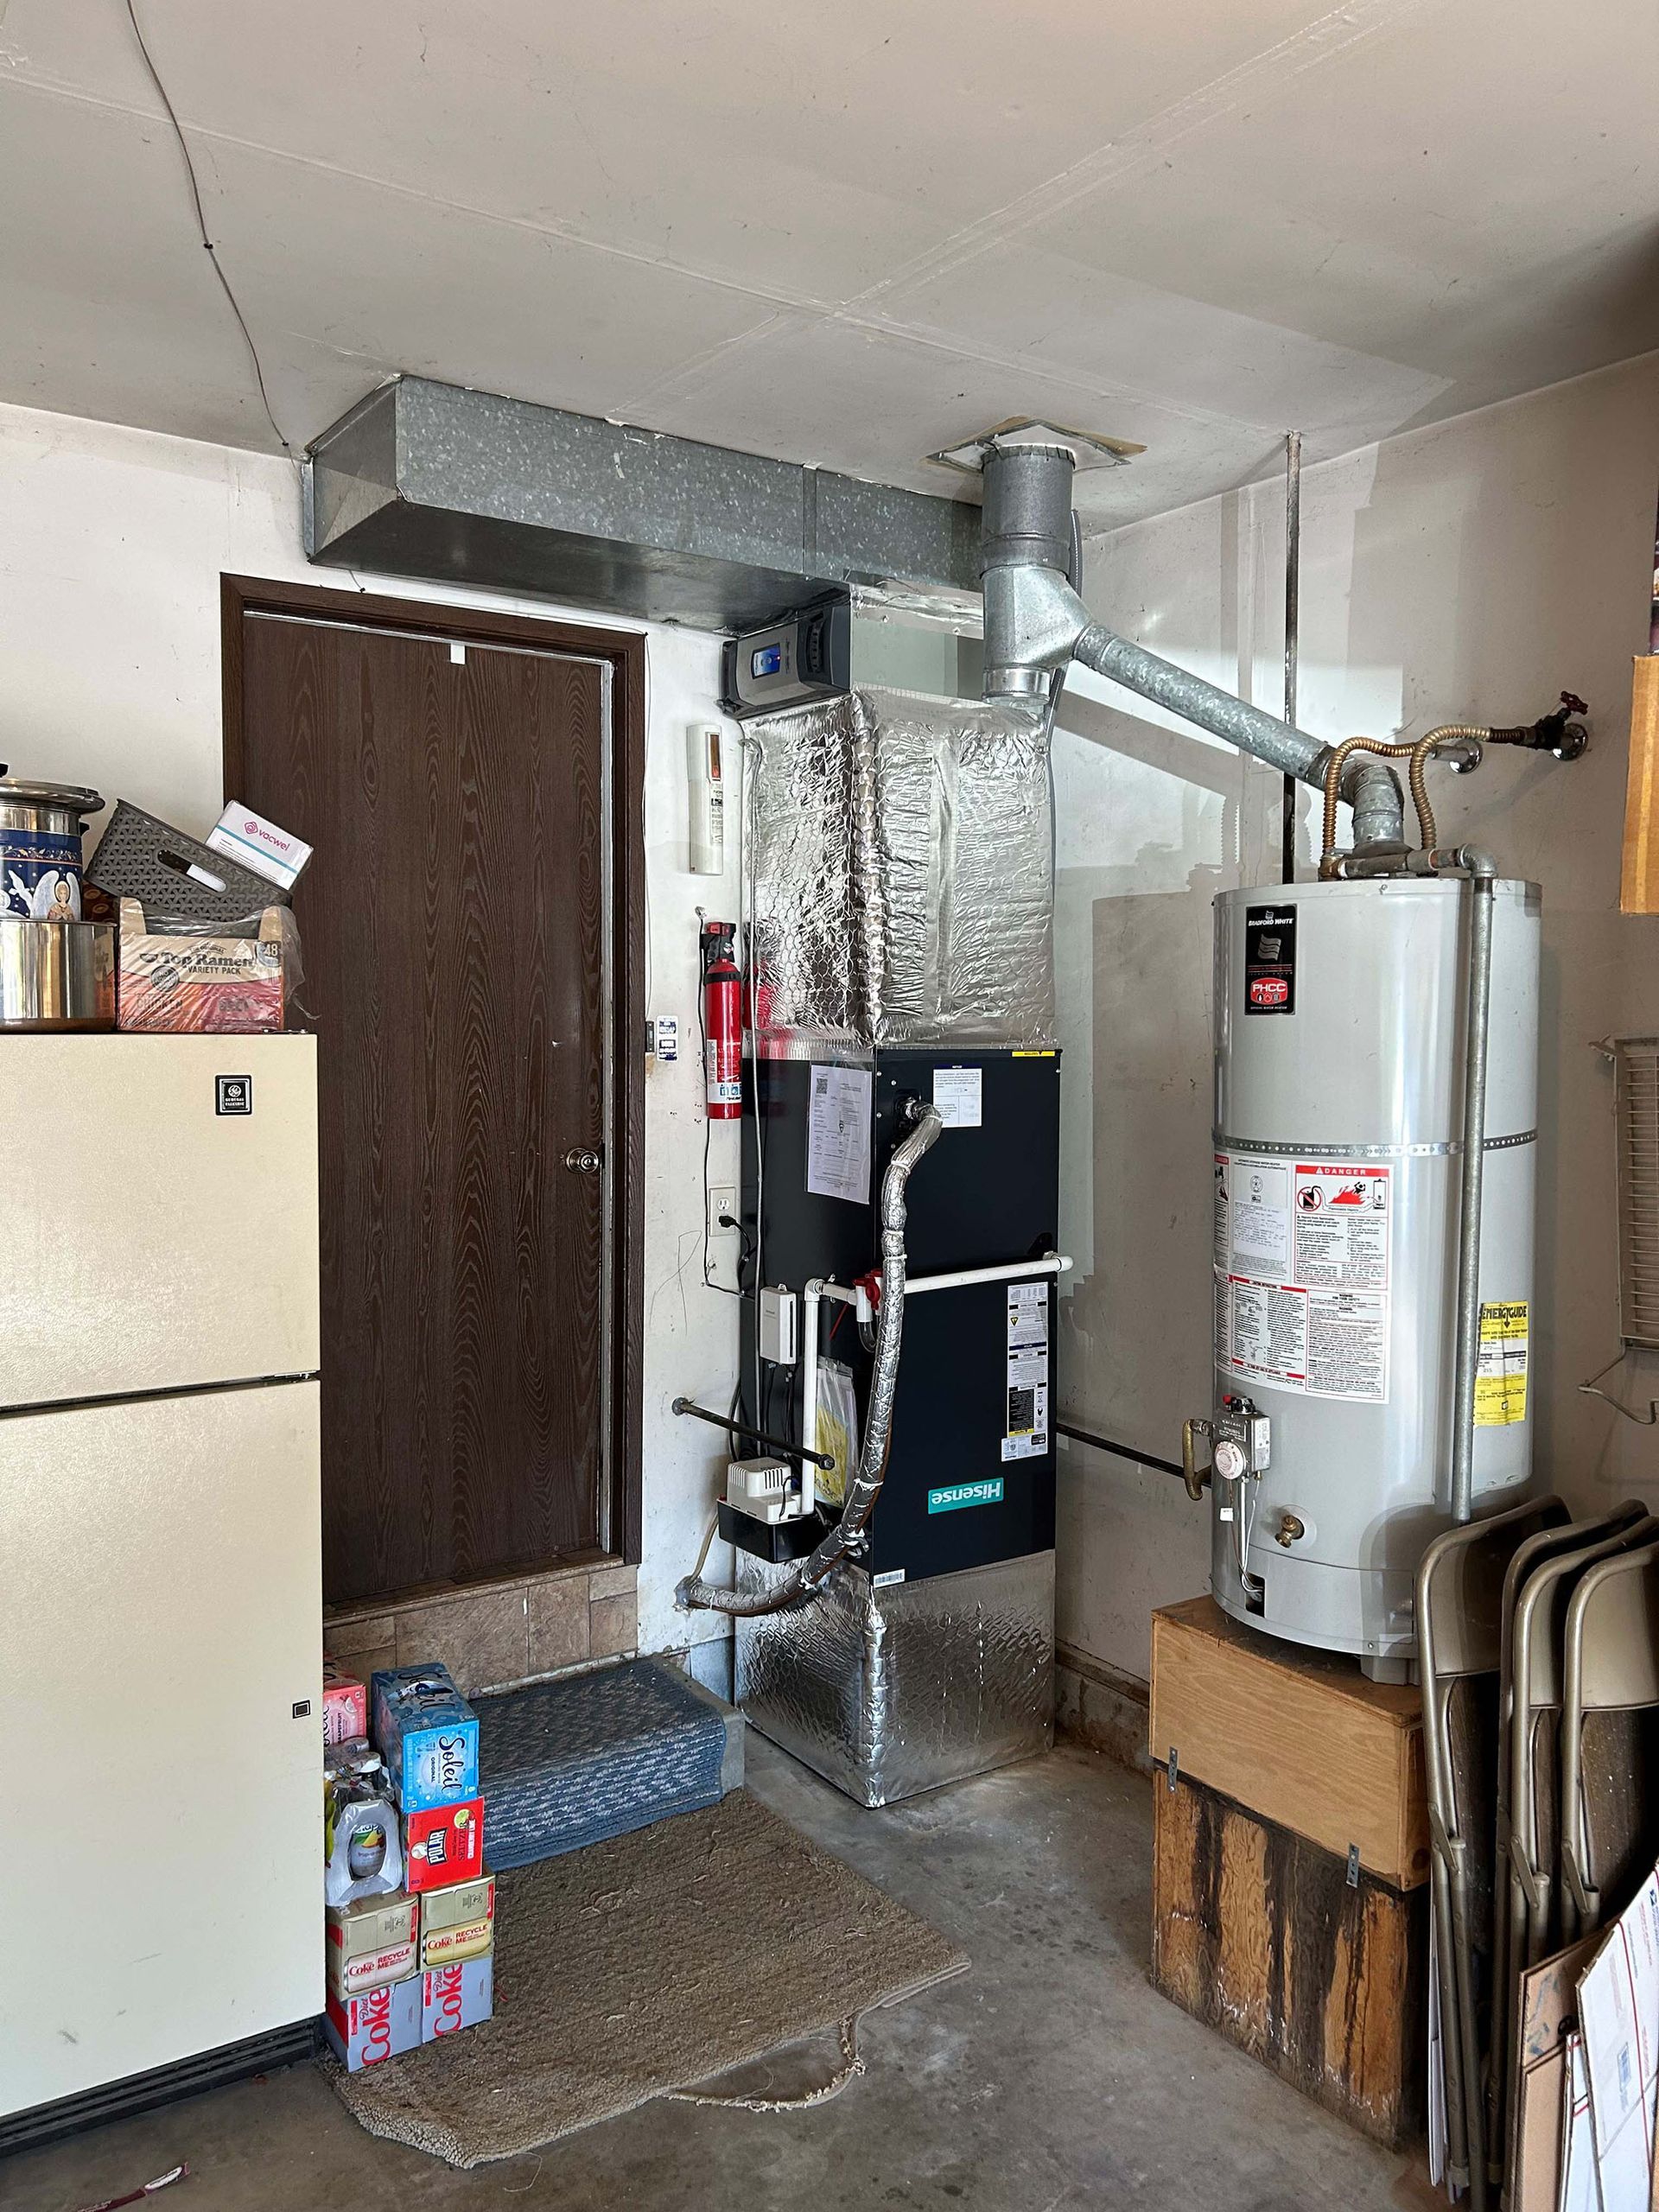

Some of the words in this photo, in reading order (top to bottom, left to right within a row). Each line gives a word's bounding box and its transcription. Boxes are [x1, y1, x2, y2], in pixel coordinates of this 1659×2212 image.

[264, 944, 278, 957] 48
[161, 951, 192, 969] Top
[195, 953, 254, 968] Ramen
[222, 966, 241, 975] PACK
[1252, 982, 1287, 993] PHCC
[1325, 1167, 1367, 1176] DANGER
[931, 1482, 1001, 1504] Hisense
[438, 1736, 466, 1794] Soleil
[428, 1829, 447, 1864] POLAR
[458, 1821, 467, 1861] SELTZER
[455, 1923, 487, 1938] RECYCLE
[427, 1936, 453, 1950] Coke
[377, 1948, 410, 1964] RECYCLE
[348, 1962, 375, 1977] Coke
[377, 1961, 391, 1970] ME
[433, 1970, 443, 1993] Diet
[434, 1963, 463, 2037] Coke
[359, 1998, 369, 2020] Diet
[361, 1986, 391, 2066] Coke
